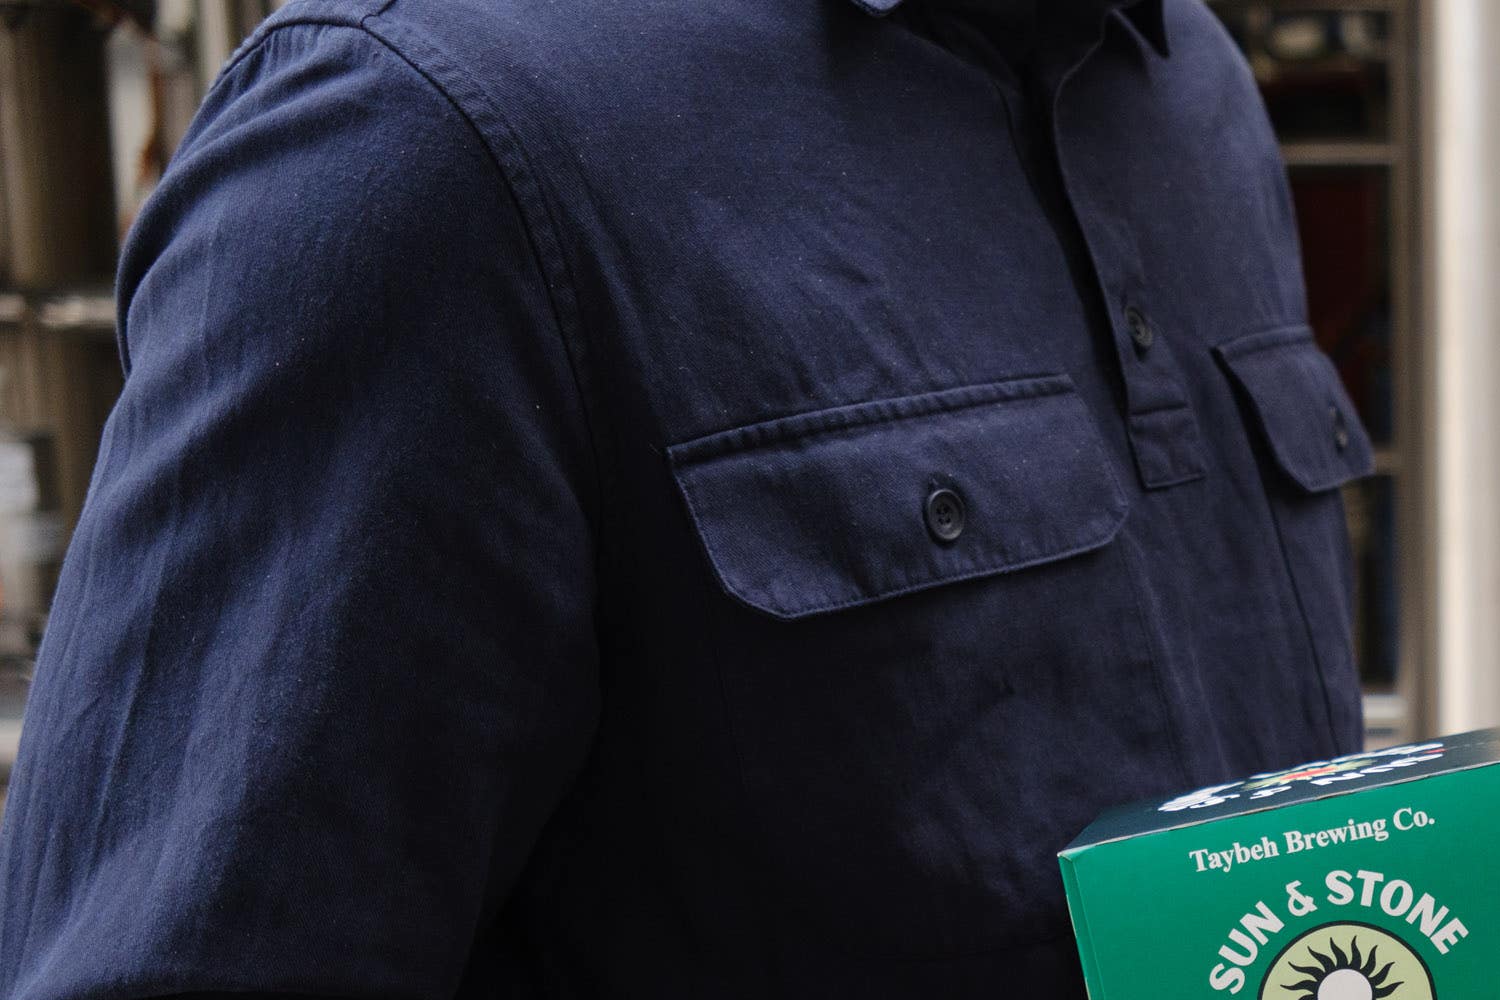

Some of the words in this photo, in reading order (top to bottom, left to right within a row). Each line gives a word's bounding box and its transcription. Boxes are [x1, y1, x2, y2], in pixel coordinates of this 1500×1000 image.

[1189, 836, 1280, 873] Taybeh
[1283, 817, 1389, 855] Brewing
[1392, 807, 1436, 831] Co.
[1209, 900, 1286, 995] SUN
[1285, 880, 1318, 917] &
[1325, 869, 1469, 955] STONE
